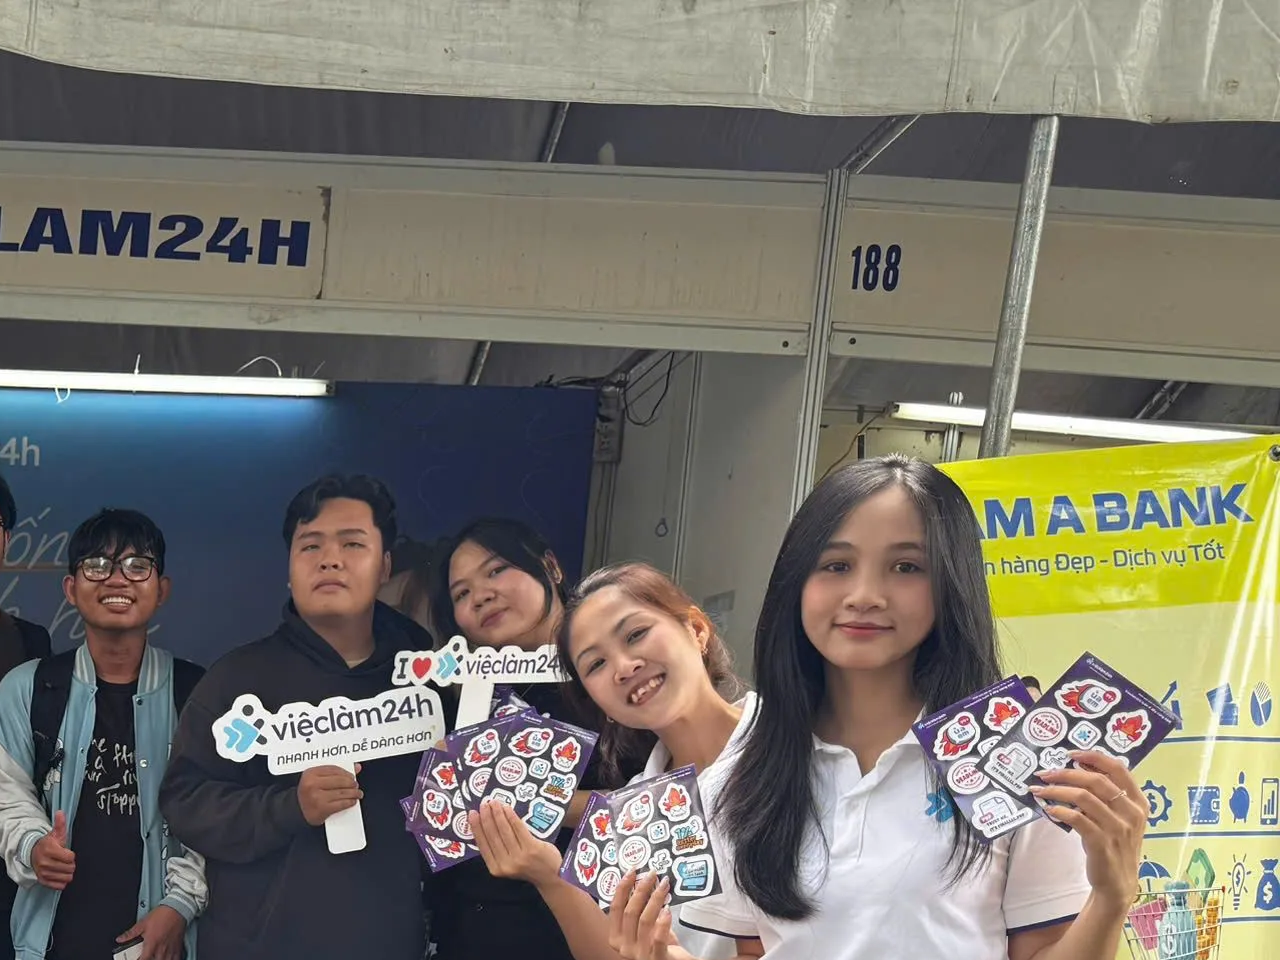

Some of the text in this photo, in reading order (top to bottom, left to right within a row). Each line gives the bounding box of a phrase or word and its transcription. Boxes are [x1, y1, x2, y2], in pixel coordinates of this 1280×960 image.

[851, 244, 902, 291] 188
[1046, 495, 1086, 535] A
[1092, 483, 1254, 533] BANK
[1001, 555, 1050, 577] hàng
[1054, 553, 1095, 575] Đẹp
[1113, 548, 1156, 571] Dịch
[1161, 550, 1185, 569] vụ
[1188, 539, 1225, 561] Tốt
[271, 693, 434, 743] việclàm24h
[1033, 717, 1058, 735] DEADLINE
[371, 735, 404, 751] DÀNG
